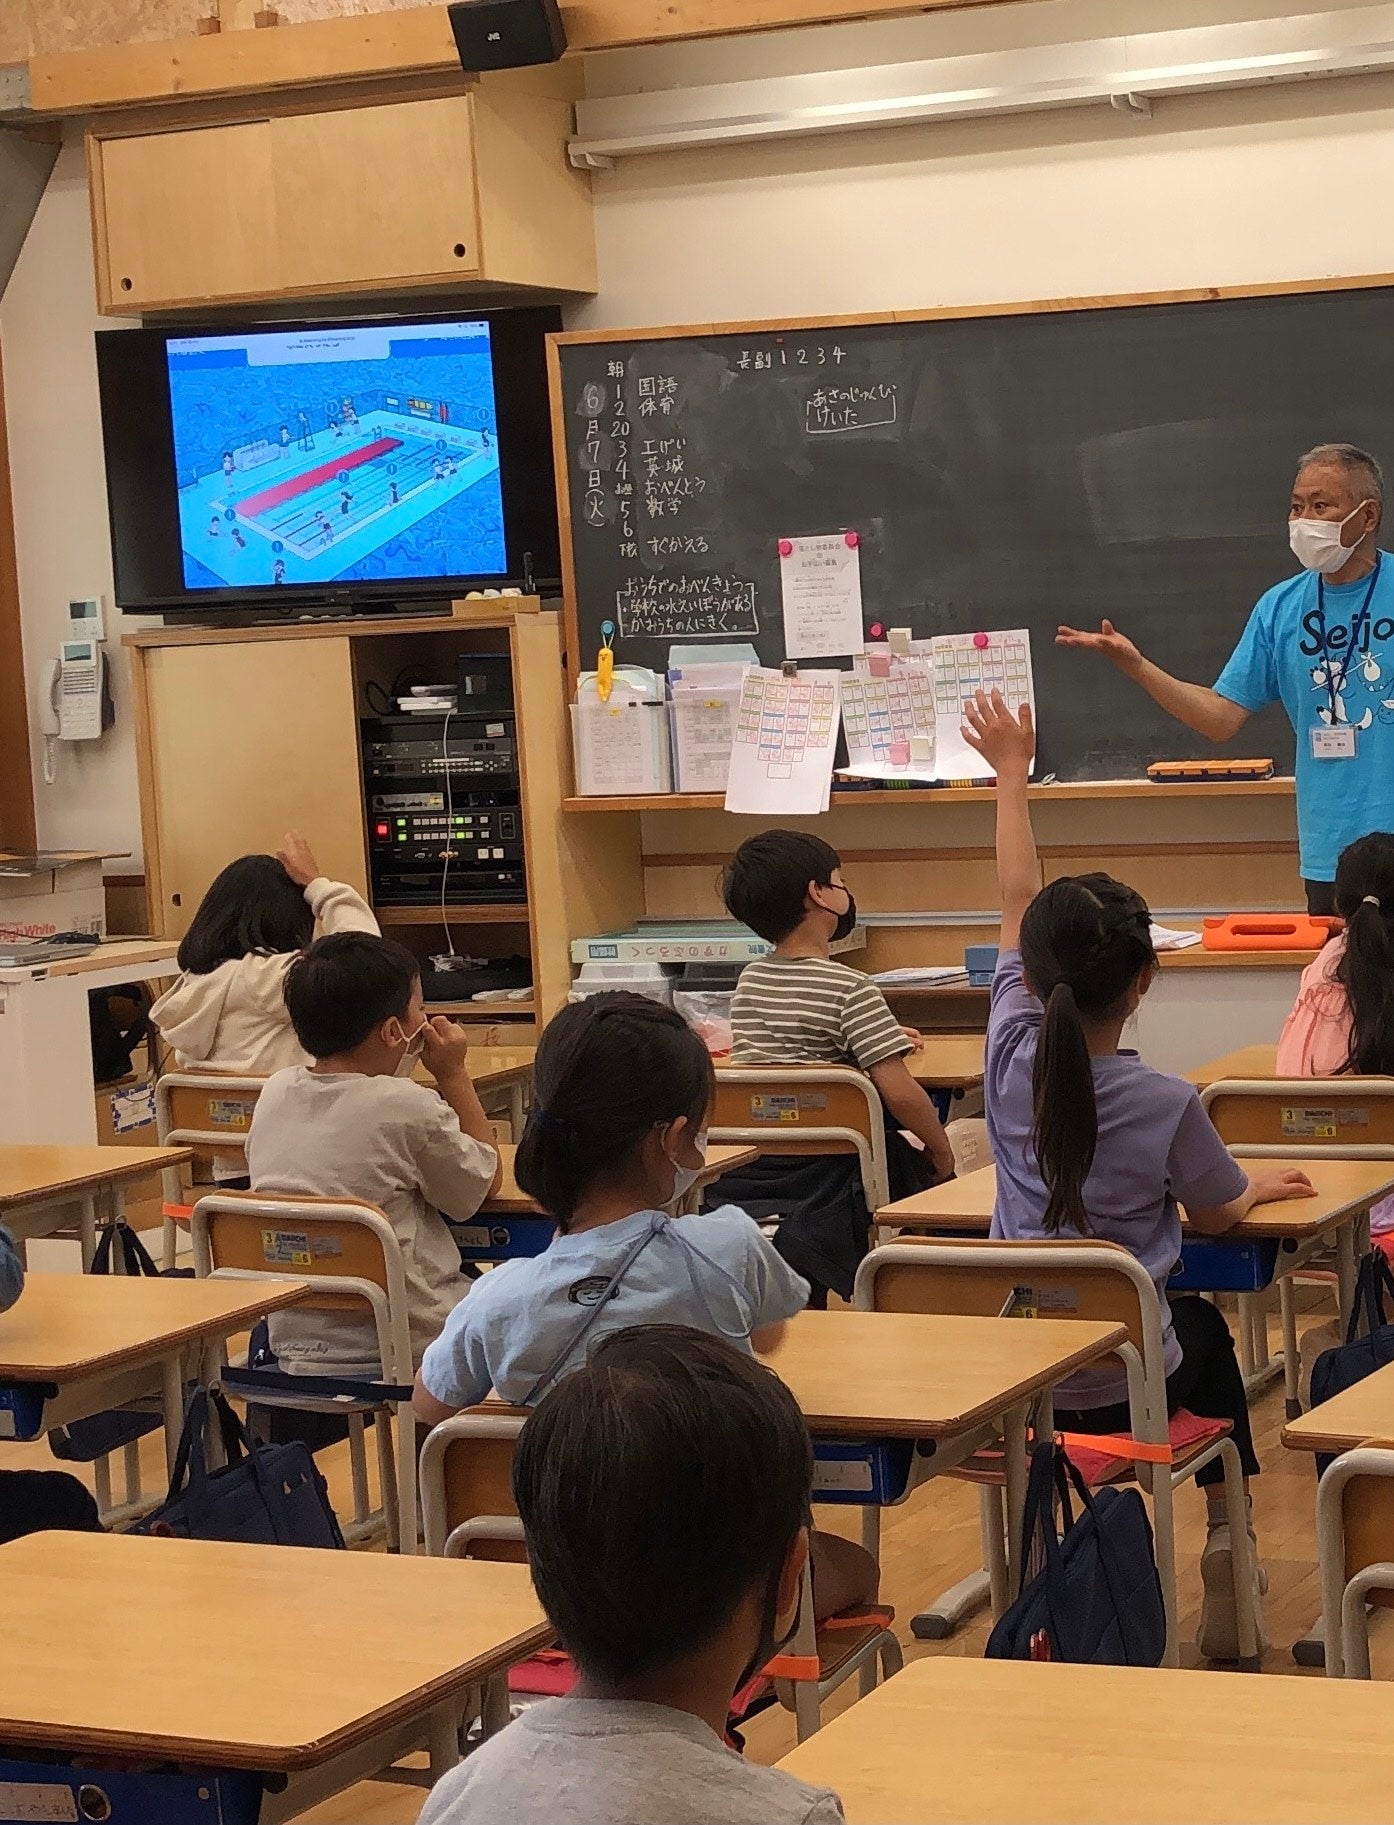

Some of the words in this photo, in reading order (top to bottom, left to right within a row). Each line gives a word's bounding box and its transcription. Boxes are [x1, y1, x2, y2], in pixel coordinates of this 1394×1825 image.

[780, 350, 786, 364] 1
[797, 349, 809, 364] 2
[817, 347, 825, 364] 3
[832, 346, 846, 364] 4
[607, 360, 624, 377] 朝
[616, 384, 621, 399] 1
[638, 376, 678, 396] 国語
[613, 401, 625, 416] 2
[638, 397, 675, 417] 体育
[610, 421, 630, 437] 20
[618, 440, 627, 458] 3
[615, 461, 631, 480] 4
[644, 476, 706, 497] おべんとう
[620, 500, 631, 519] 5
[623, 521, 634, 537] 6
[646, 536, 709, 556] すぐかえる
[755, 1097, 762, 1106] 3
[1286, 1110, 1293, 1119] 3
[267, 1233, 272, 1243] 3
